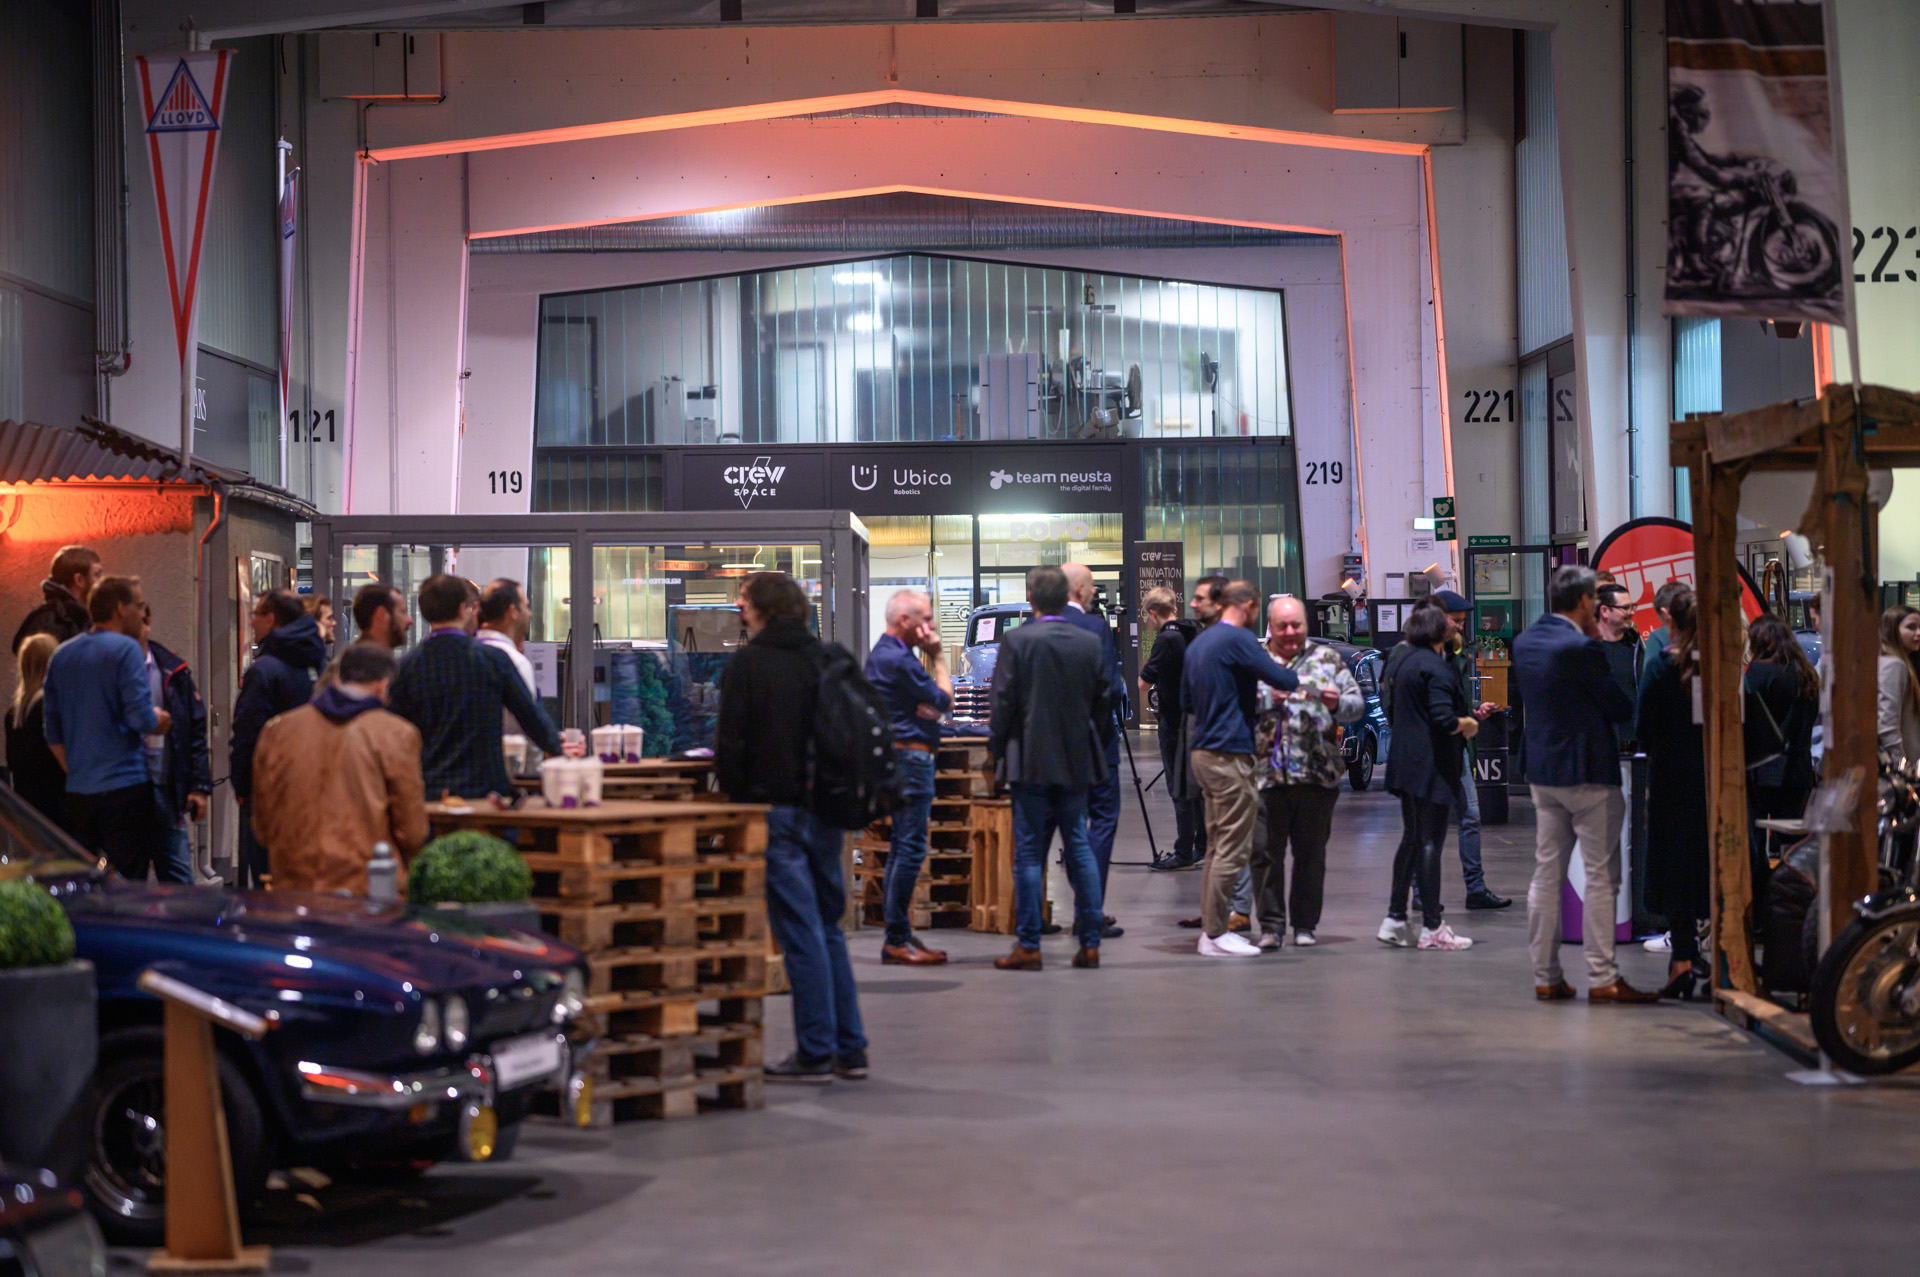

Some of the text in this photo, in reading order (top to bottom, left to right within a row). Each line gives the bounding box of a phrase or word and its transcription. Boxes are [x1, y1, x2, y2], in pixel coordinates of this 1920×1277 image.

[161, 111, 205, 125] LLOYD
[1464, 389, 1514, 423] 221
[893, 469, 952, 486] Ubica
[1016, 470, 1112, 484] team neusta
[1305, 461, 1343, 485] 219
[488, 470, 523, 494] 119
[1071, 484, 1091, 493] digital
[1091, 484, 1112, 492] family
[733, 488, 777, 497] SPACE
[893, 488, 921, 496] Robotics
[1010, 520, 1090, 542] POPO
[1141, 552, 1162, 562] crew
[1139, 566, 1183, 579] INNOVATION
